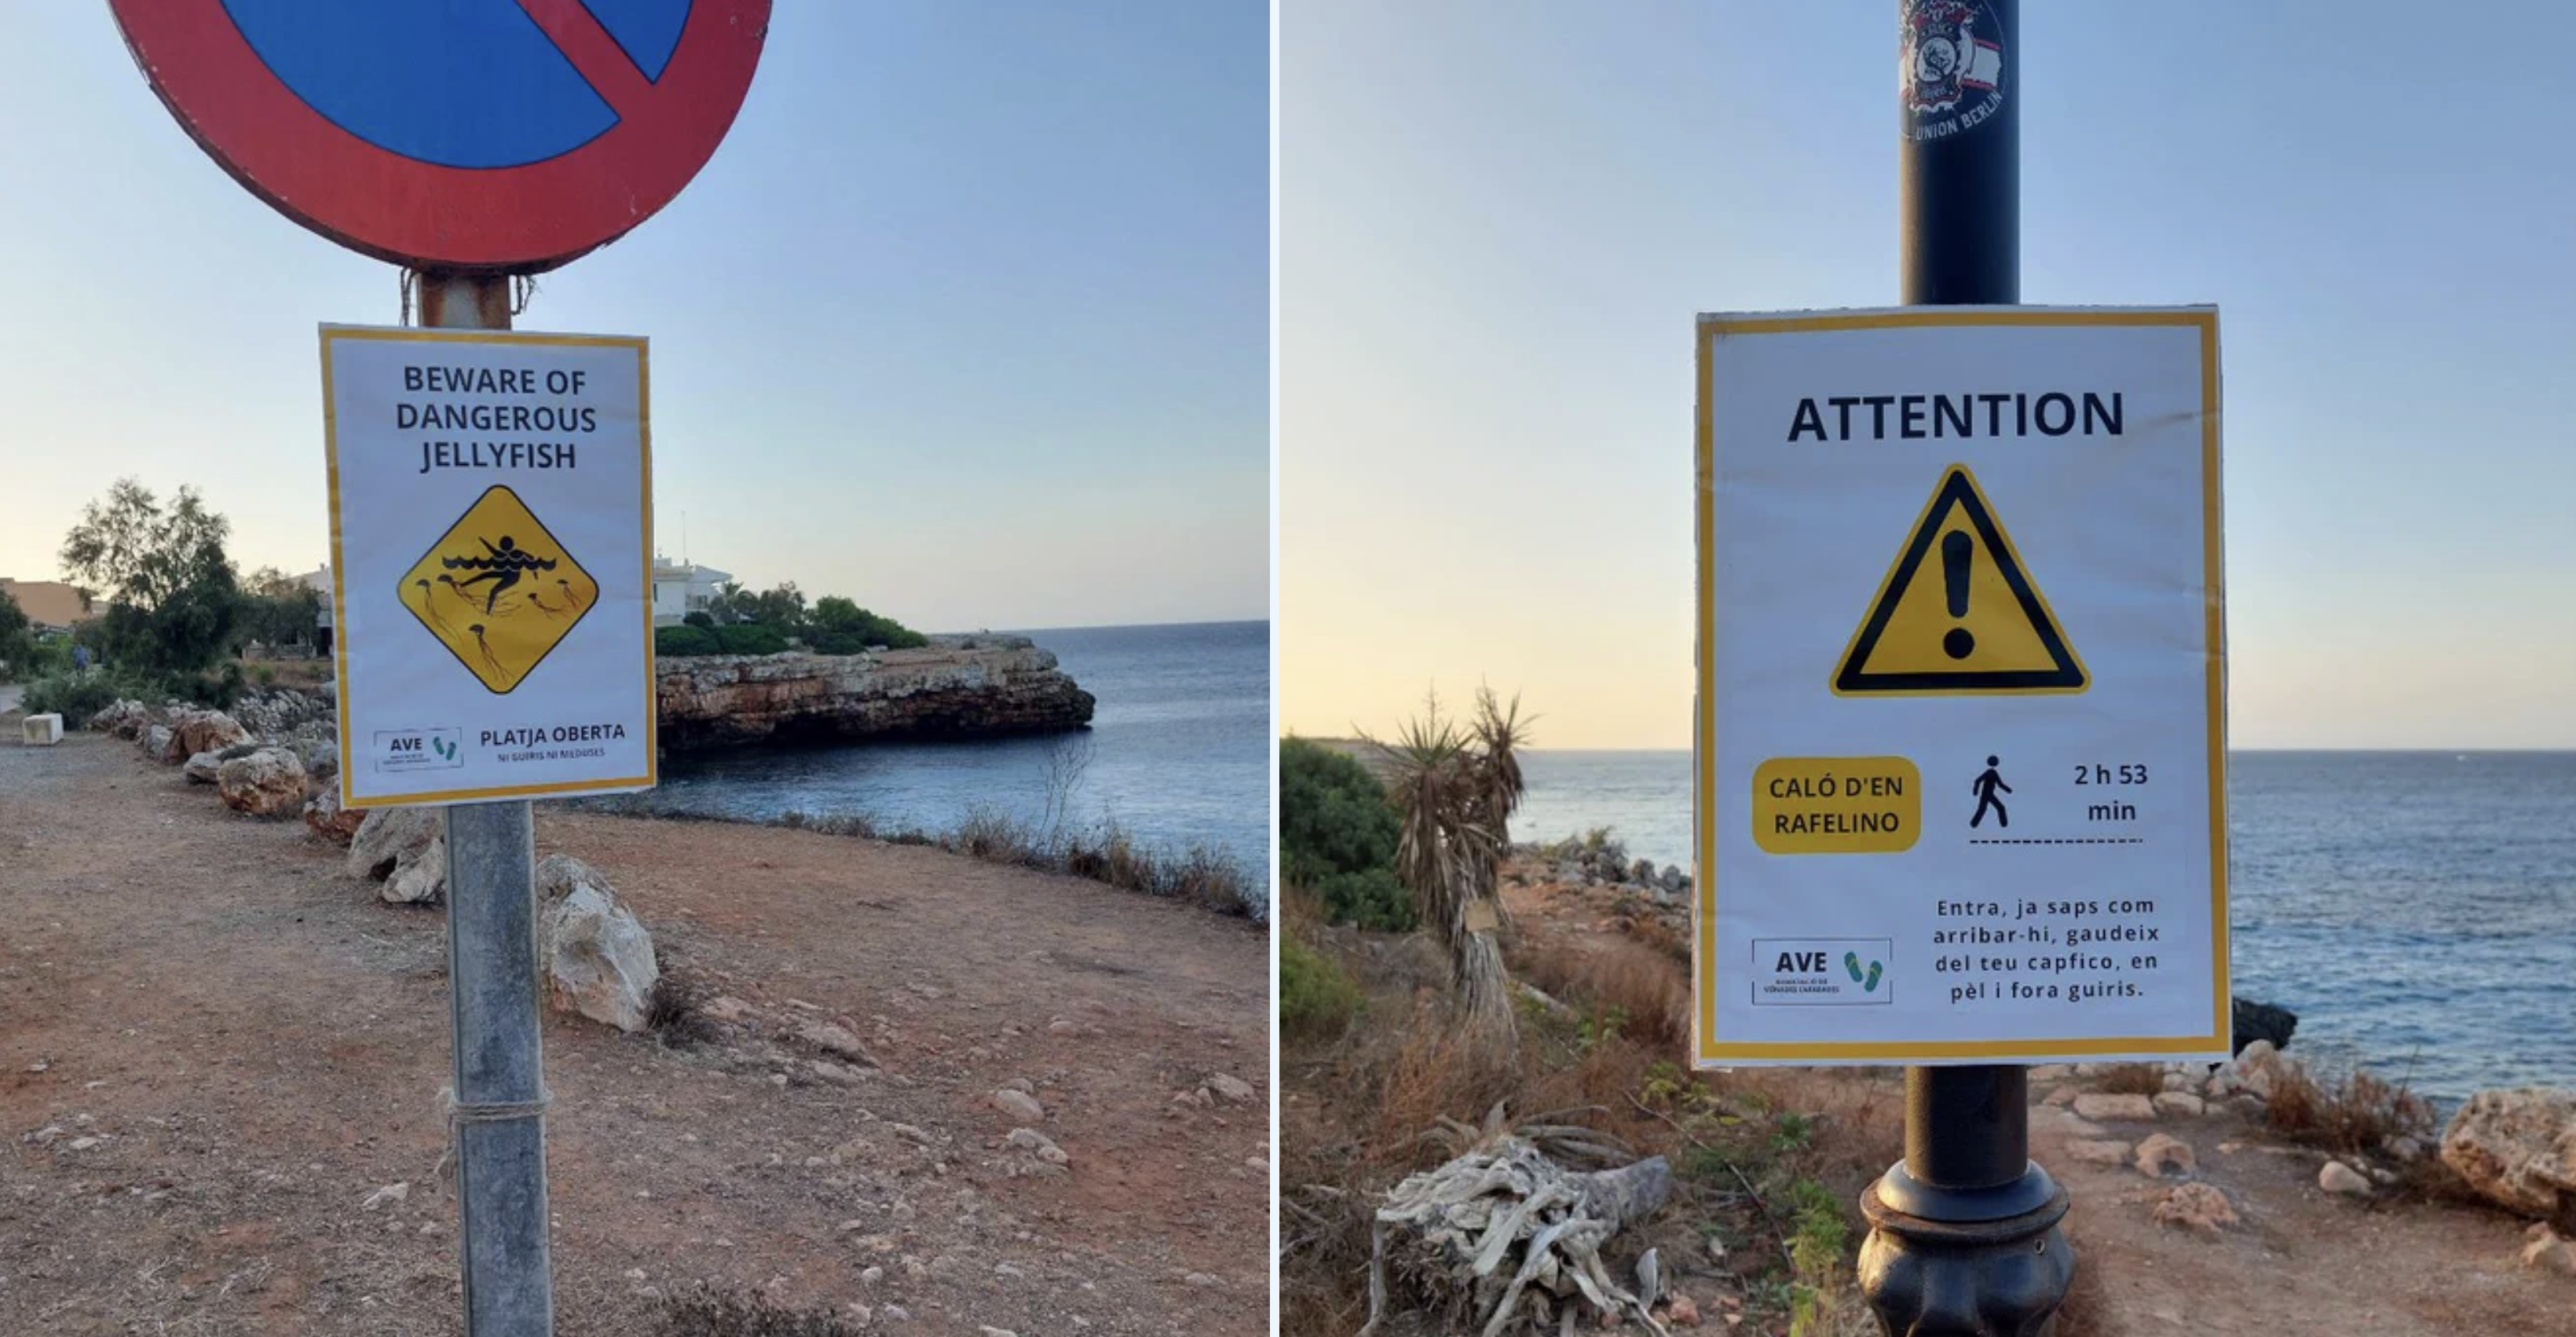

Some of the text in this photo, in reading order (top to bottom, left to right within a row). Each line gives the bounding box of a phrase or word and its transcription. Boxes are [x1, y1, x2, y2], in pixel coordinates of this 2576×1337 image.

[1916, 90, 2003, 141] UNION BERLIN
[404, 366, 586, 395] BEWARE OF
[397, 403, 596, 433] DANGEROUS
[1787, 392, 2123, 442] ATTENTION
[419, 441, 576, 474] JELLYFISH
[390, 738, 423, 752] AVE
[481, 723, 625, 749] PLATJA OBERTA
[1769, 772, 1902, 798] CALÓ D'EN
[2075, 764, 2148, 785] 2 h 53
[1775, 812, 1900, 833] RAFELINO
[2088, 800, 2136, 821] min
[1937, 898, 2153, 921] Entra, ja saps com
[1934, 924, 2159, 947] arribar-hi, gaudeix
[1775, 951, 1827, 973] AVE
[1935, 952, 2157, 975] del teu capfico, en
[1951, 980, 2143, 1005] pèl i fora guiris.
